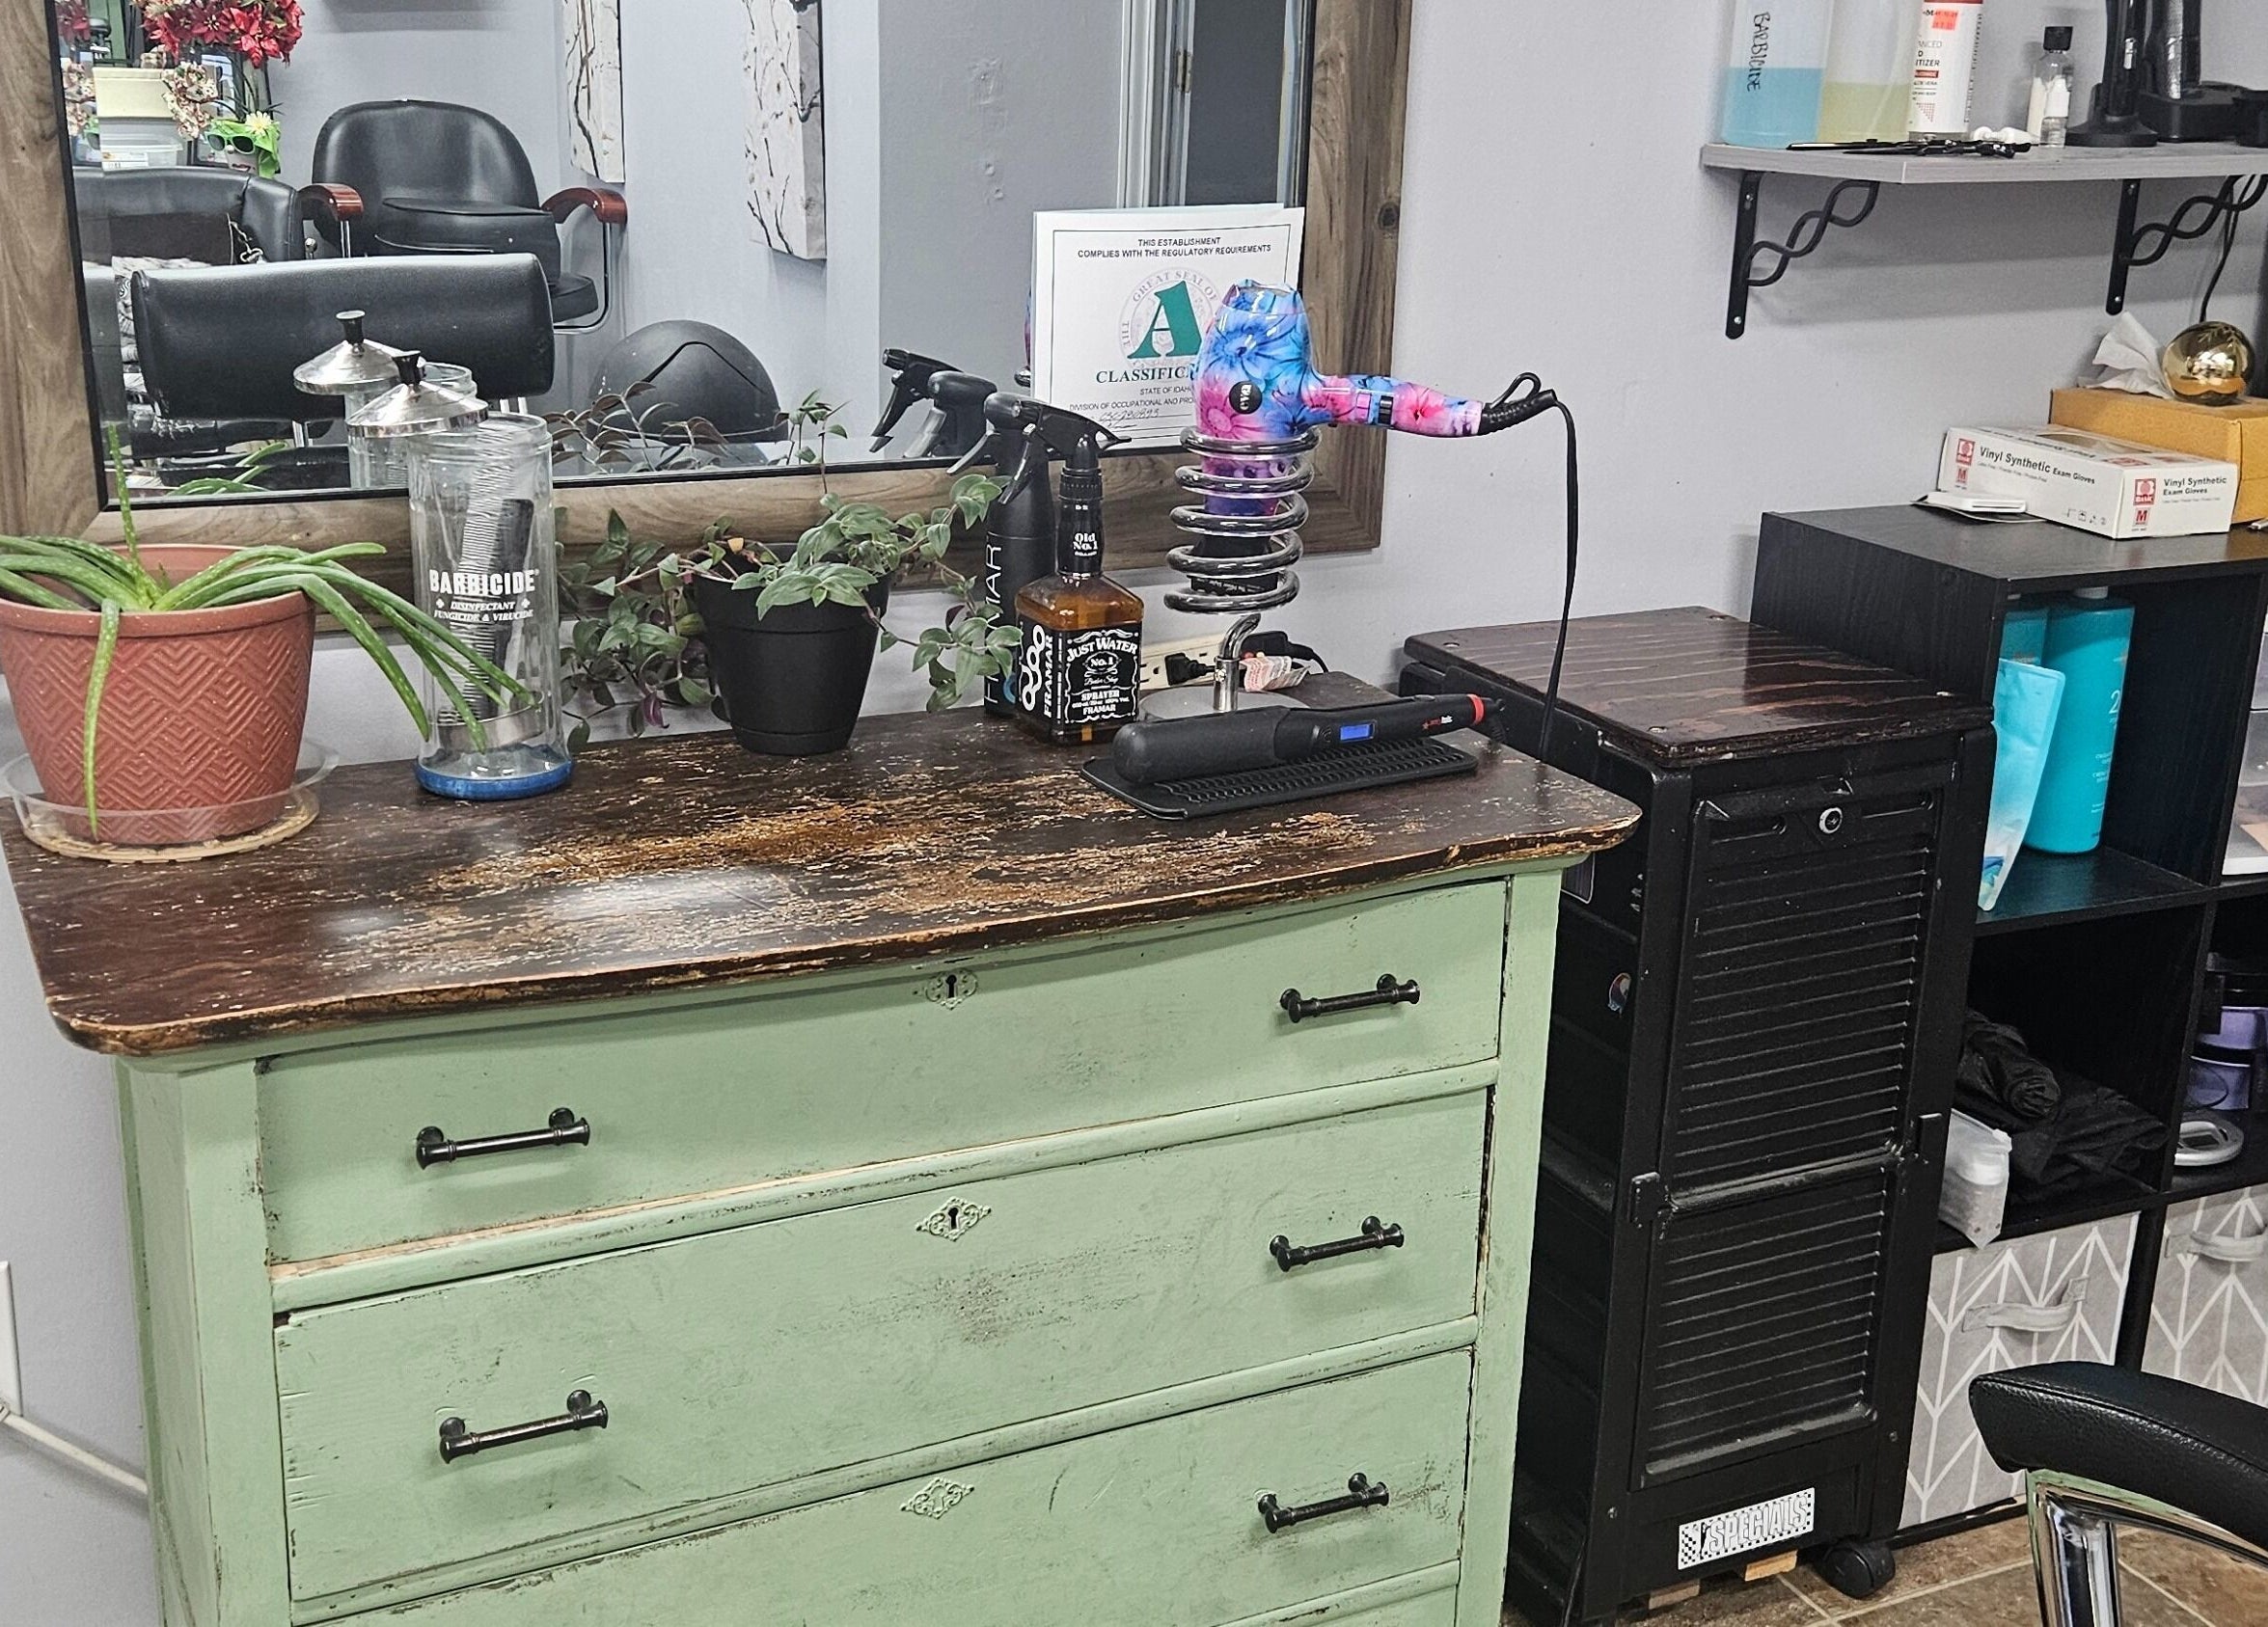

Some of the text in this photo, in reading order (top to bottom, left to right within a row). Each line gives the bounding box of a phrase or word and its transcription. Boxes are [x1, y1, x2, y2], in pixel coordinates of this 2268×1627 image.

[1746, 11, 1771, 93] BARBICIDE
[1138, 237, 1221, 247] THIS ESTABLISHMENT
[1078, 250, 1120, 258] COMPLIES
[1161, 248, 1214, 258] REGULATORY
[1215, 244, 1271, 256] REQUIREMENTS
[1127, 280, 1202, 359] A
[1110, 398, 1162, 408] OCCUPATIONAL
[1980, 446, 2004, 462] Vinyl
[2005, 452, 2051, 474] Synthetic
[2052, 468, 2071, 478] Exam
[2072, 473, 2095, 484] Gloves
[2163, 475, 2227, 488] Vinyl Synthetic
[2136, 509, 2147, 522] M
[1074, 532, 1096, 545] Old
[428, 568, 536, 596] BARBICIDE
[450, 601, 516, 611] DISINFECTANT
[433, 610, 533, 622] FUNGICIDE & VIRUCIDE
[1066, 637, 1138, 663] JUST WATER
[1044, 635, 1053, 719] FRAMAR
[1080, 690, 1120, 702] SPRAYER
[1082, 704, 1116, 716] FRAMAR
[1708, 1495, 1808, 1554] SPECIALS
